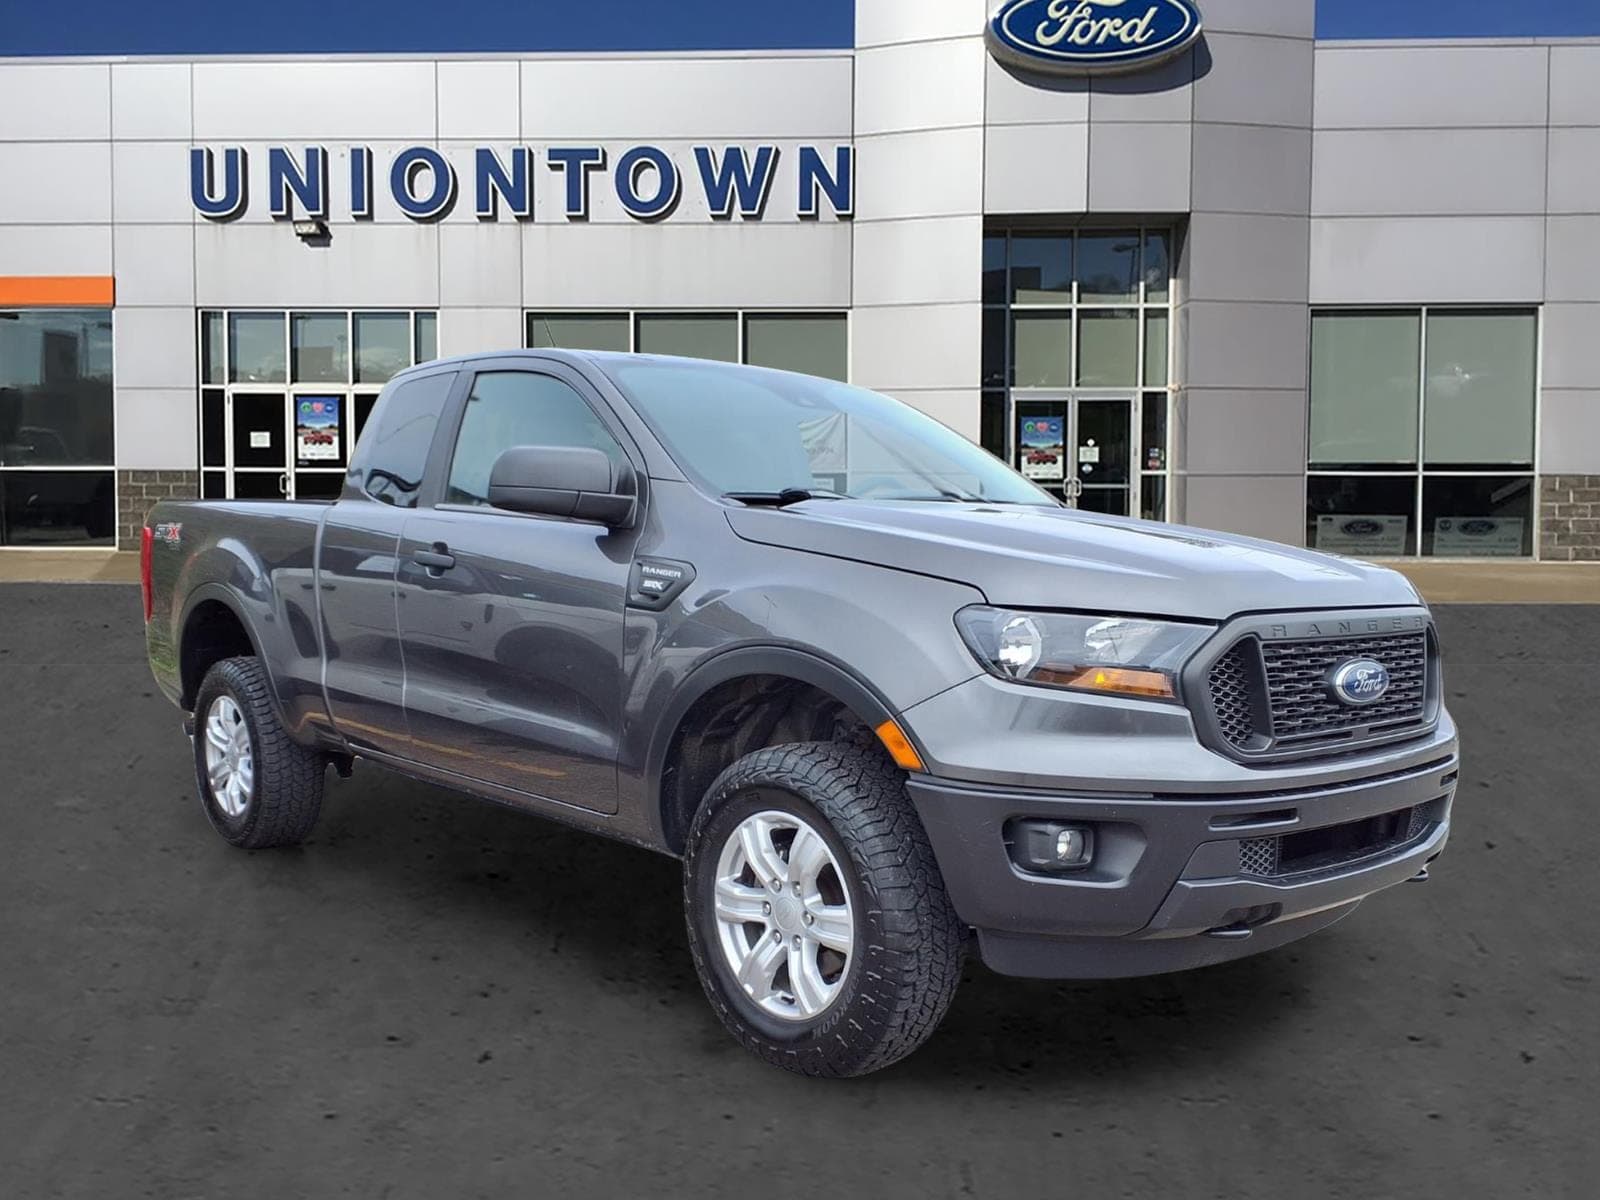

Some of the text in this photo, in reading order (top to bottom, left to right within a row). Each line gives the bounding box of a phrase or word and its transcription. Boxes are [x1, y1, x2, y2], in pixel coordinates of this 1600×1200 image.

[1035, 0, 1159, 46] Ford
[190, 144, 854, 220] UNIONTOWN
[642, 566, 681, 578] RANGER
[1271, 617, 1424, 637] RANGER
[1353, 668, 1383, 694] Ford
